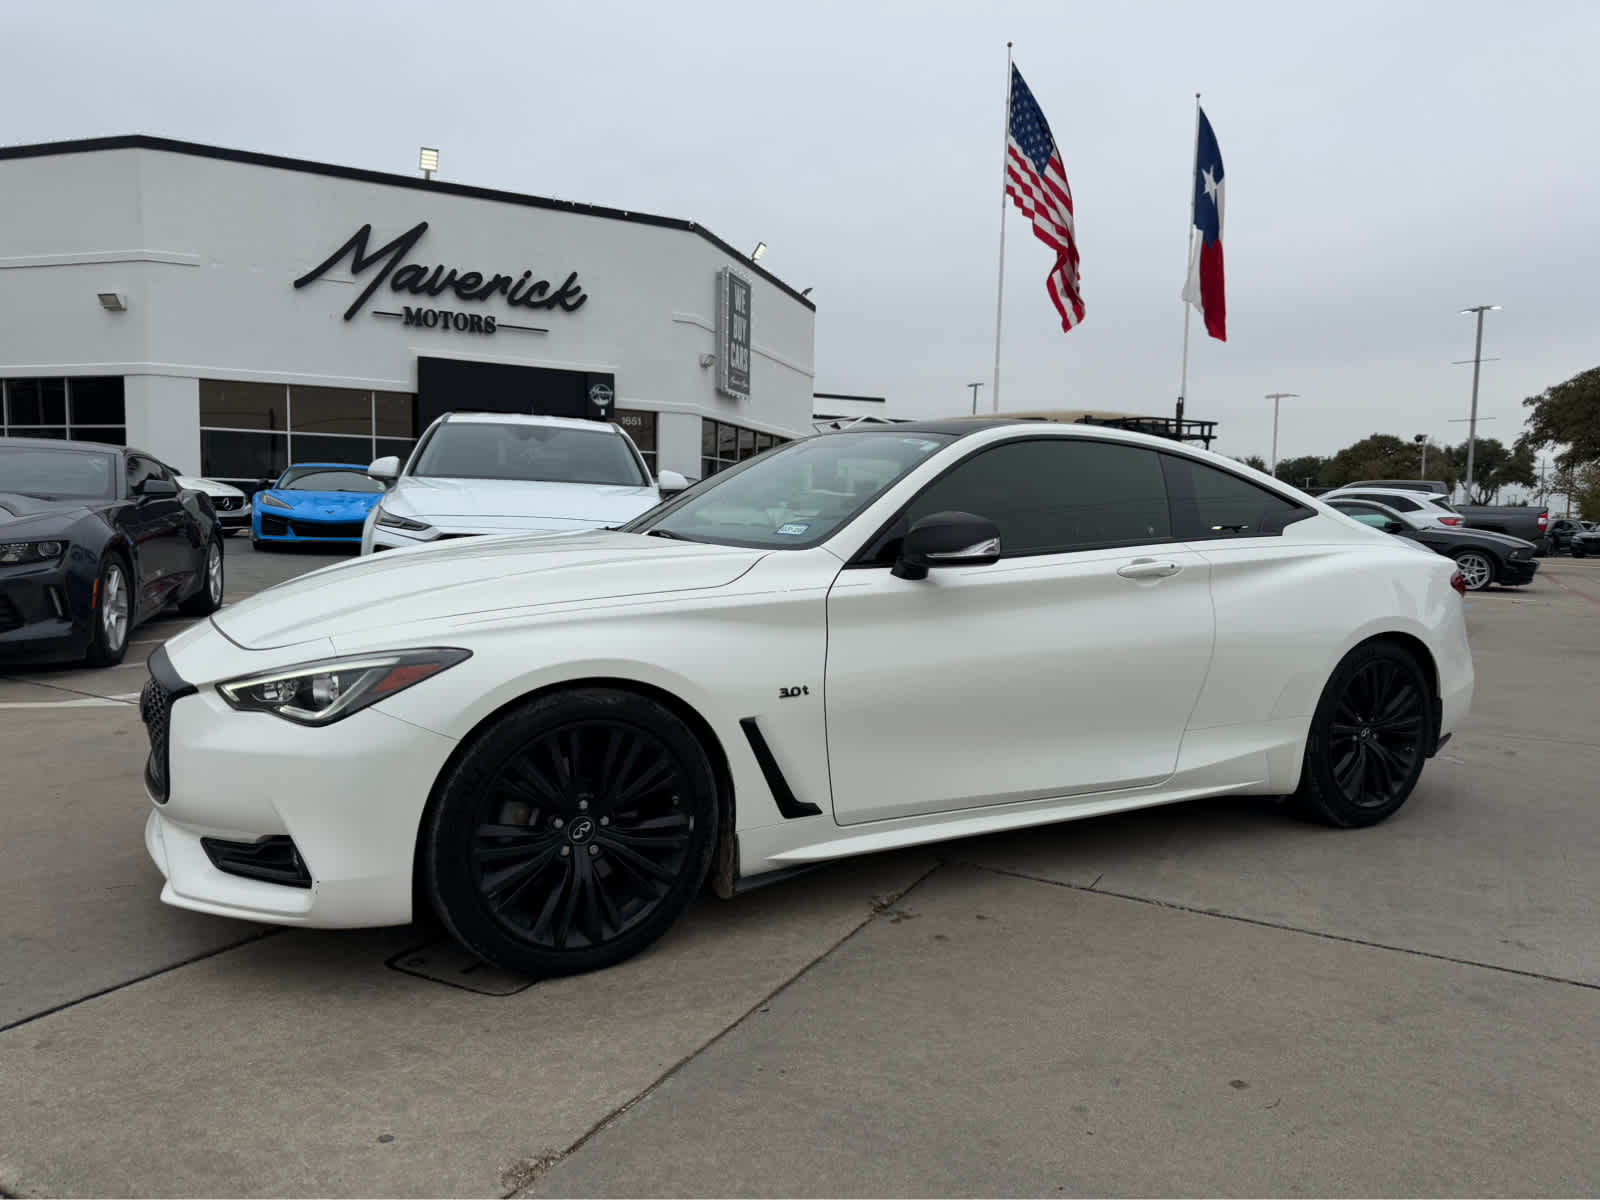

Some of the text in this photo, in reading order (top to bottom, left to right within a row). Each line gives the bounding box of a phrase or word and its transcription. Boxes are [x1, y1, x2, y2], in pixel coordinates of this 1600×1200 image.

[293, 221, 588, 321] Maverick
[734, 283, 747, 315] WE
[403, 306, 497, 334] MOTORS
[732, 312, 747, 345] BUY
[730, 341, 749, 373] CARS
